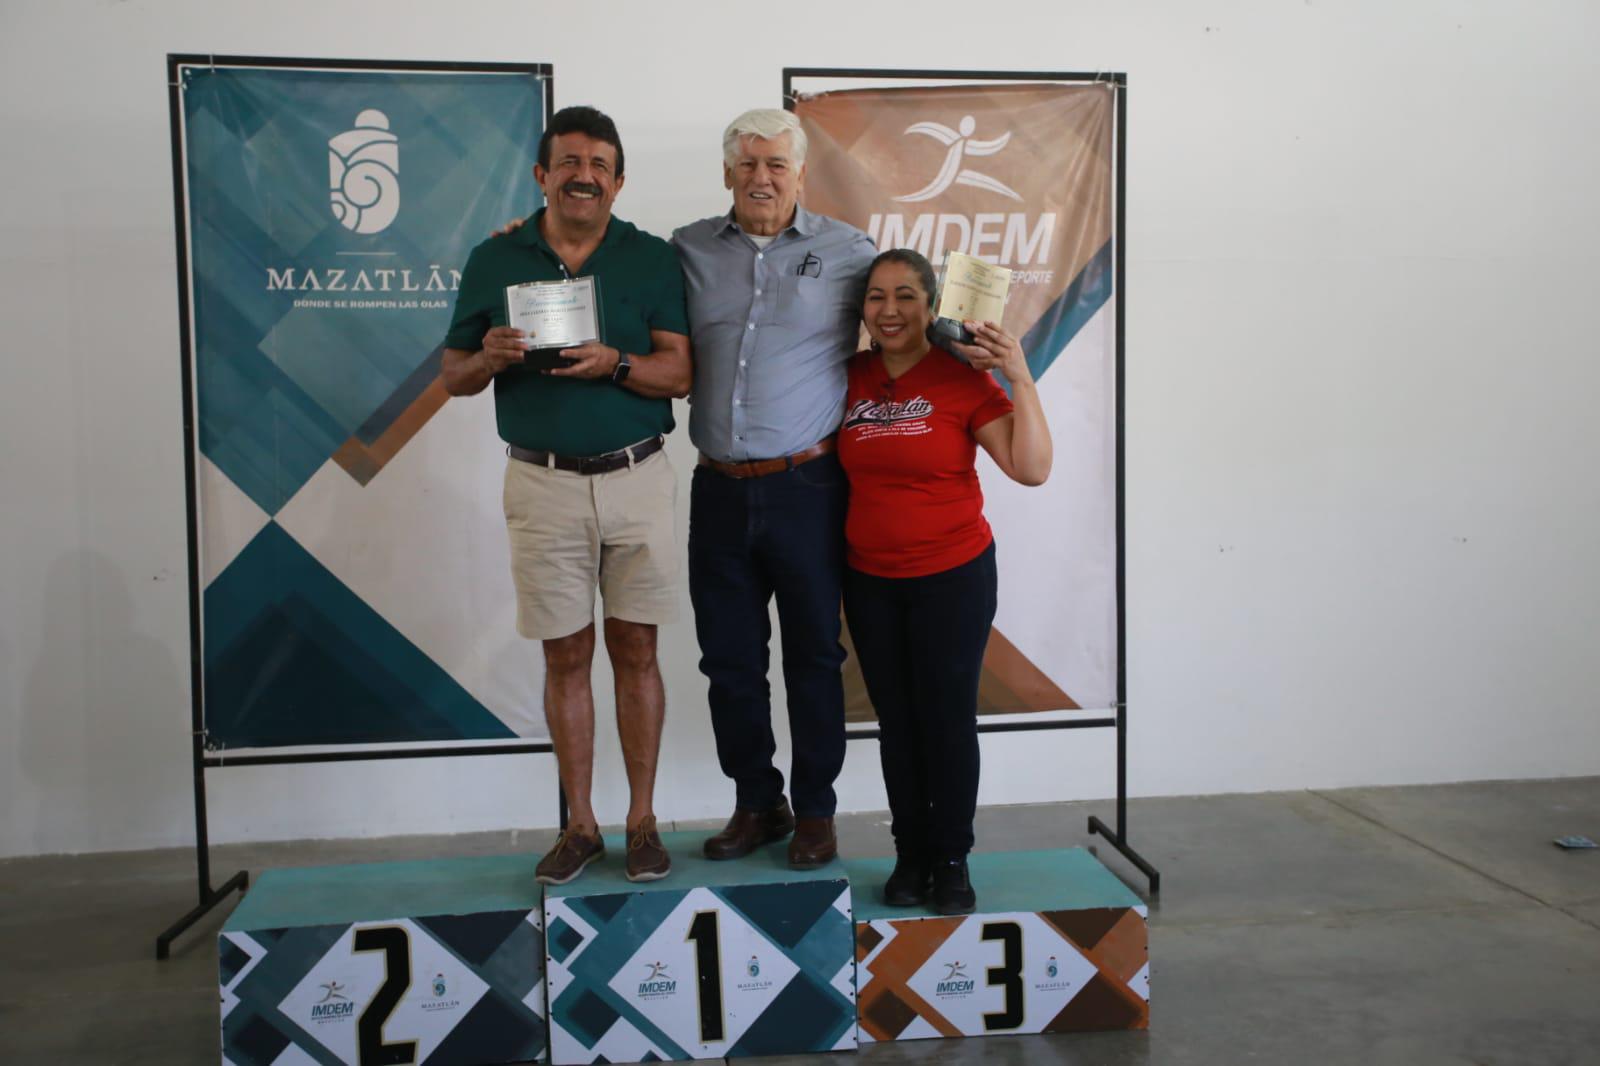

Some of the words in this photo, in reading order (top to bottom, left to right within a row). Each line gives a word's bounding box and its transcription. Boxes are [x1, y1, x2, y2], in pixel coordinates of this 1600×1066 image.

[866, 212, 1056, 265] IMDEM
[1010, 271, 1055, 284] EPORTE
[334, 299, 347, 308] SE
[350, 299, 397, 308] ROMPEN
[399, 299, 418, 308] LAS
[420, 299, 448, 309] OLAS
[686, 909, 725, 1043] 1
[980, 920, 1024, 1033] 3
[638, 980, 676, 994] IMDEM
[935, 979, 975, 993] IMDEM
[351, 924, 419, 1066] 2
[311, 1001, 354, 1017] IMDEM
